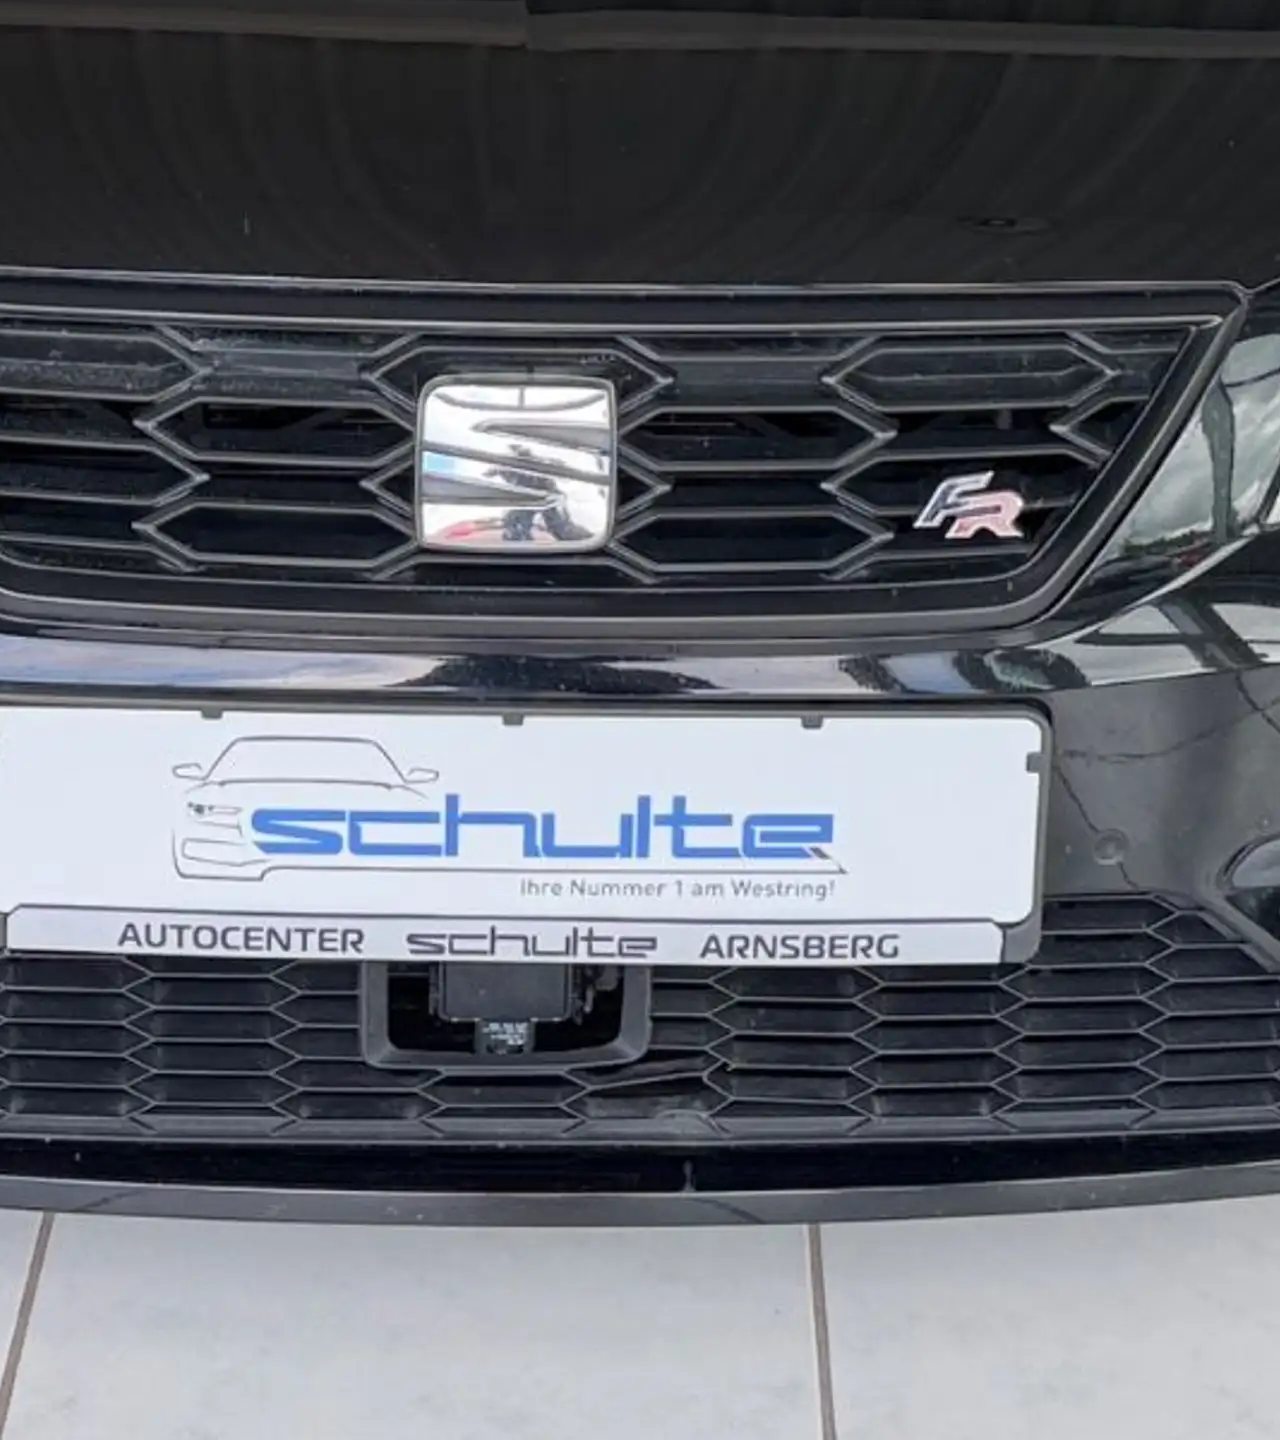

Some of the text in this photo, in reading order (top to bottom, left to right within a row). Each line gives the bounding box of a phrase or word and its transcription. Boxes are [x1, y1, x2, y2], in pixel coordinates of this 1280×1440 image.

[251, 793, 834, 859] schulte
[519, 878, 836, 902] Ihre Nummer 1 am Westring!
[117, 922, 901, 960] AUTOCENTER schulte ARNSBERG
